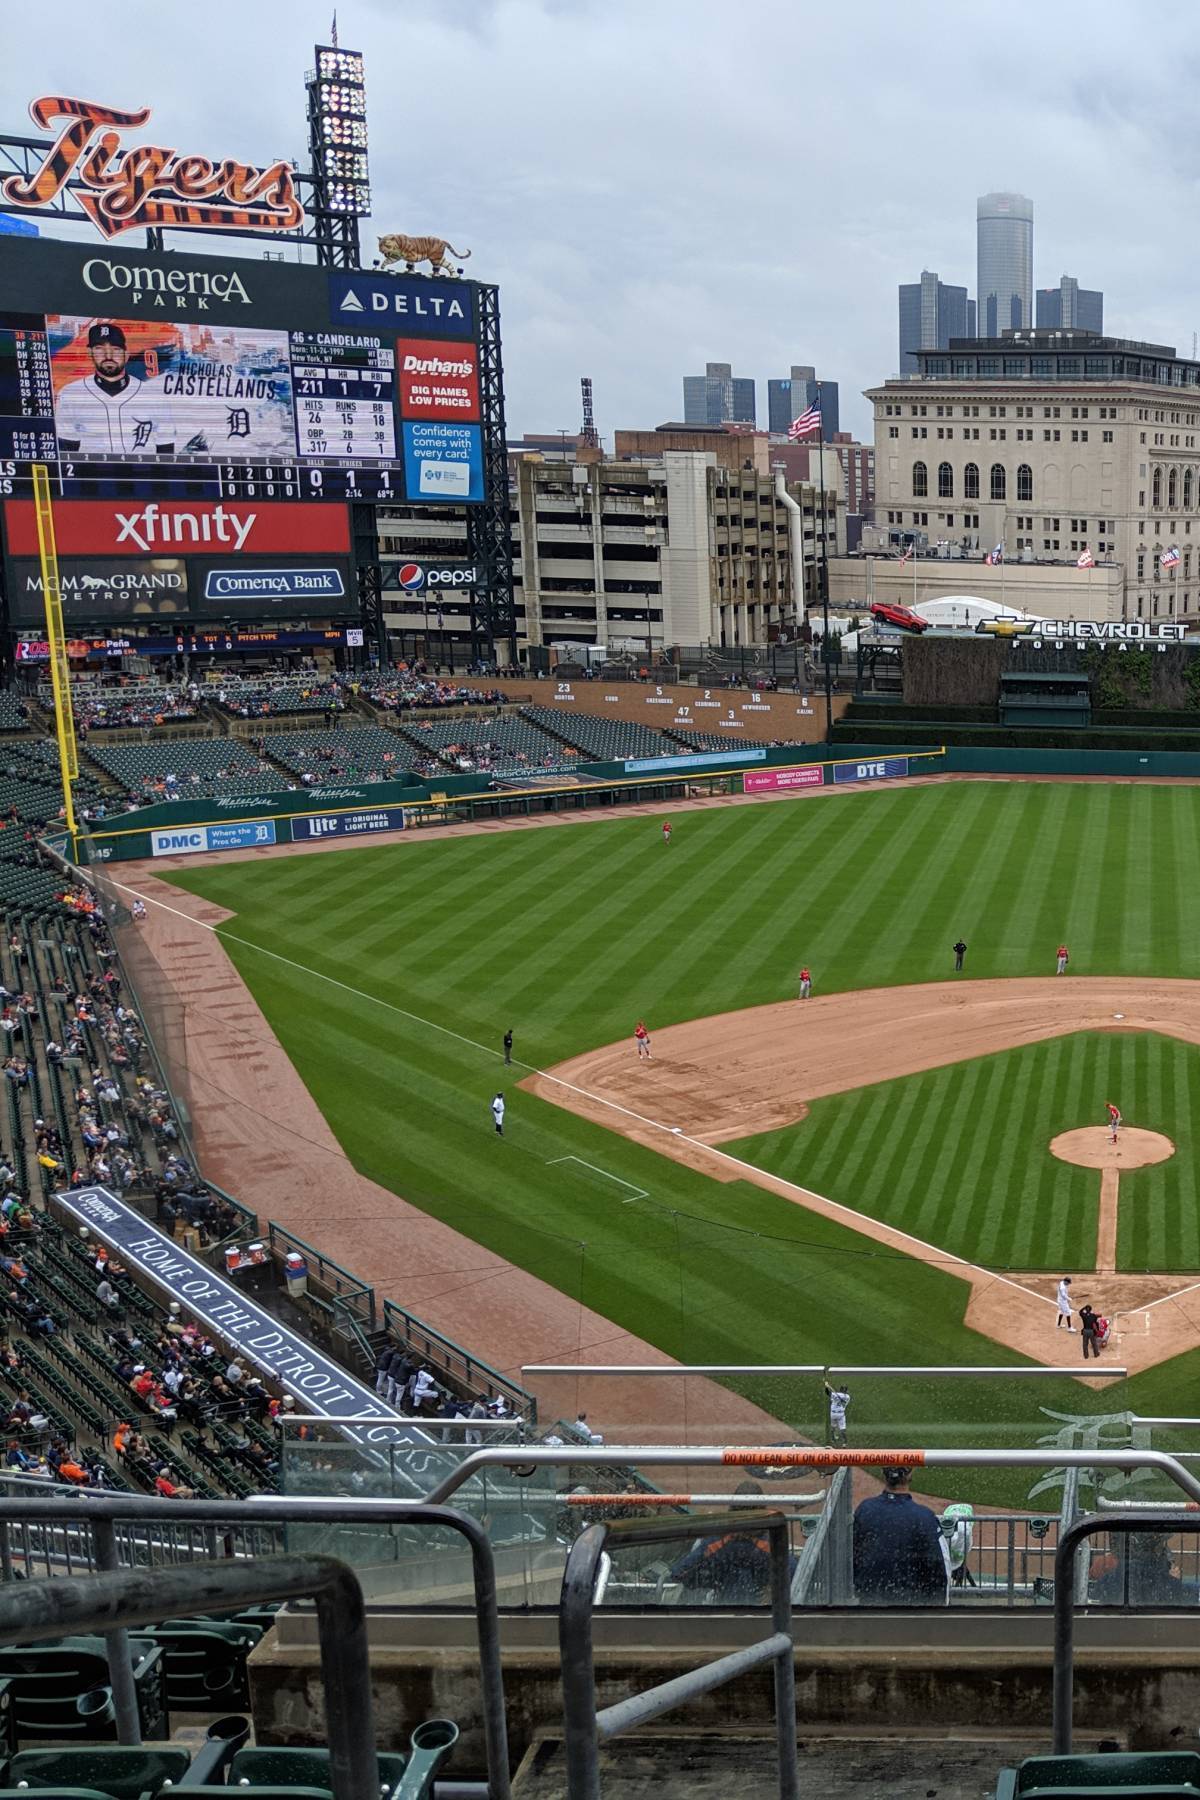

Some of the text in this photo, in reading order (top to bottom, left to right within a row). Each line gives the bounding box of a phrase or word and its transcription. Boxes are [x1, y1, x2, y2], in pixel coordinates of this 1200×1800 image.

[2, 97, 303, 240] Tigers
[133, 292, 210, 310] PARK
[372, 293, 465, 318] DELTA
[16, 341, 46, 350] RF .276
[292, 332, 380, 348] 46 CANDELARIO
[32, 361, 48, 369] .226
[144, 350, 159, 378] 9
[404, 355, 473, 375] Dunham's
[179, 362, 233, 378] NICHOLAS
[303, 369, 317, 377] AVG
[338, 371, 347, 379] HR
[163, 374, 277, 400] CASTELLANOS
[298, 380, 323, 394] .211
[341, 382, 347, 395] 1
[374, 384, 381, 397] 7
[411, 386, 468, 397] BIG NAMES
[21, 389, 50, 397] SS .261
[305, 400, 323, 409] HITS
[336, 402, 356, 411] RUNS
[409, 396, 471, 407] LOW PRICES
[308, 412, 321, 423] 26
[342, 413, 353, 424] 15
[373, 415, 385, 426] 18
[308, 429, 323, 437] OBP
[343, 431, 353, 439] 2B
[375, 432, 384, 440] 3B
[412, 425, 471, 437] Confidence
[307, 441, 327, 453] .317
[346, 442, 352, 453] 6
[413, 438, 471, 448] comes with
[414, 449, 443, 460] every
[311, 470, 322, 487] 0
[346, 470, 355, 487] 1
[381, 471, 389, 488] 1
[345, 489, 362, 498] 2:14
[115, 504, 256, 549] xfinity
[110, 573, 182, 589] GRAND
[294, 574, 333, 588] Bank
[427, 567, 477, 586] pepsi
[57, 590, 155, 600] DETROIT
[1040, 619, 1189, 640] CHEVROLET
[106, 639, 130, 648] Peña
[352, 636, 359, 644] 5
[1012, 640, 1166, 652] FOUNTAIN
[558, 684, 570, 692] 23
[656, 687, 662, 695] 5
[704, 690, 711, 699] 2
[752, 694, 760, 702] 16
[802, 698, 807, 706] 6
[678, 707, 689, 716] 47
[728, 711, 734, 719] 3
[492, 765, 577, 779] MotorCityCasino.com
[857, 763, 885, 777] DTE
[309, 814, 388, 836] Lite ORIGINAL
[345, 821, 389, 831] LIGHT BEER
[212, 829, 236, 837] Where
[158, 834, 201, 849] DMC
[127, 1238, 193, 1280] HOME
[182, 1280, 221, 1300] OF
[209, 1300, 260, 1333] THE
[248, 1331, 354, 1405] DETROIT
[724, 1454, 736, 1463] DO
[739, 1454, 756, 1463] NOT
[786, 1454, 799, 1463] SIT
[803, 1454, 815, 1463] ON
[817, 1454, 830, 1463] OR
[832, 1454, 861, 1463] STAND
[863, 1454, 900, 1463] AGAINST
[903, 1454, 921, 1463] RAIL
